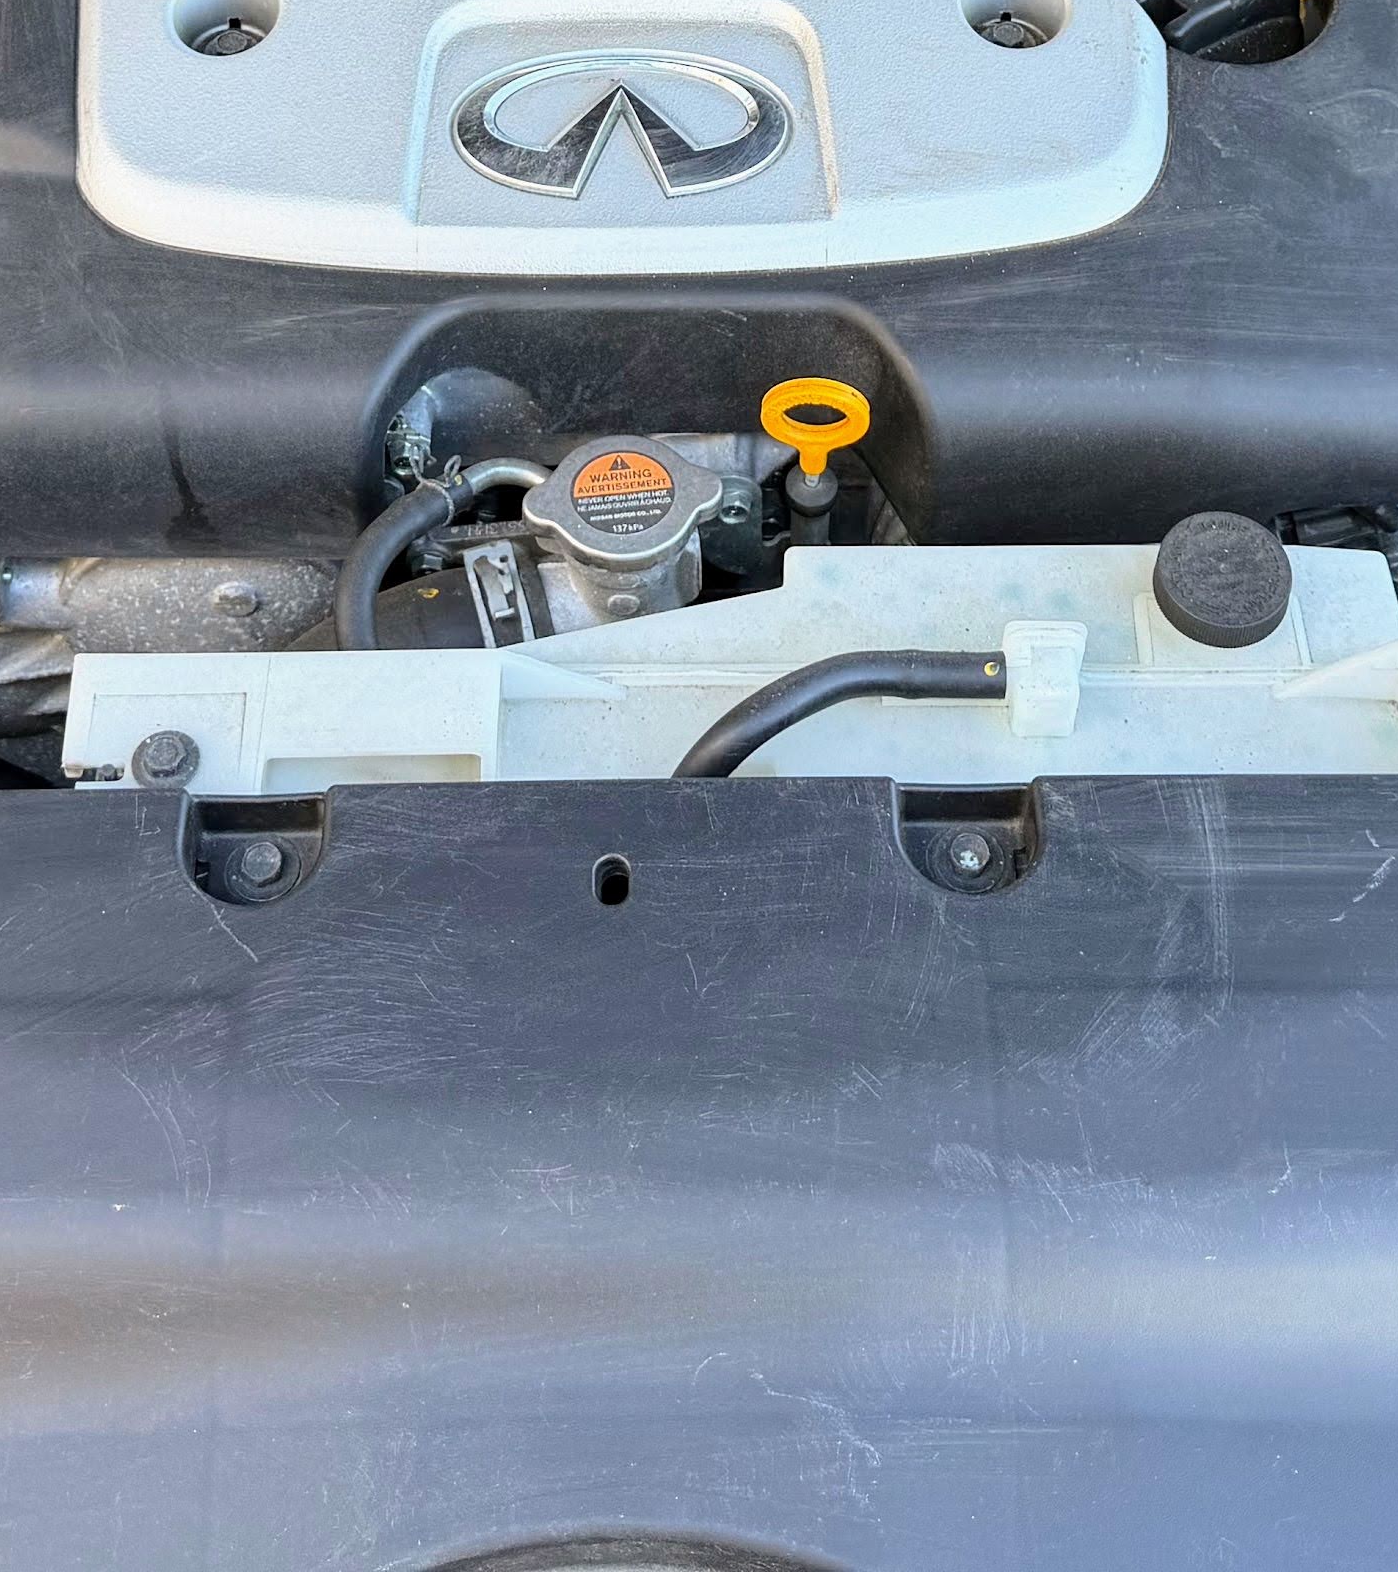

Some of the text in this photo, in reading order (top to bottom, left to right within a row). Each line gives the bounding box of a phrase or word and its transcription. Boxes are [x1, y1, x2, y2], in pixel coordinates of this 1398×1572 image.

[590, 469, 652, 483] WARNING
[578, 478, 666, 493] AVERTISSEMENT
[605, 494, 625, 502] OPEN
[627, 491, 650, 500] WHEN
[588, 503, 612, 511] JAMAIS
